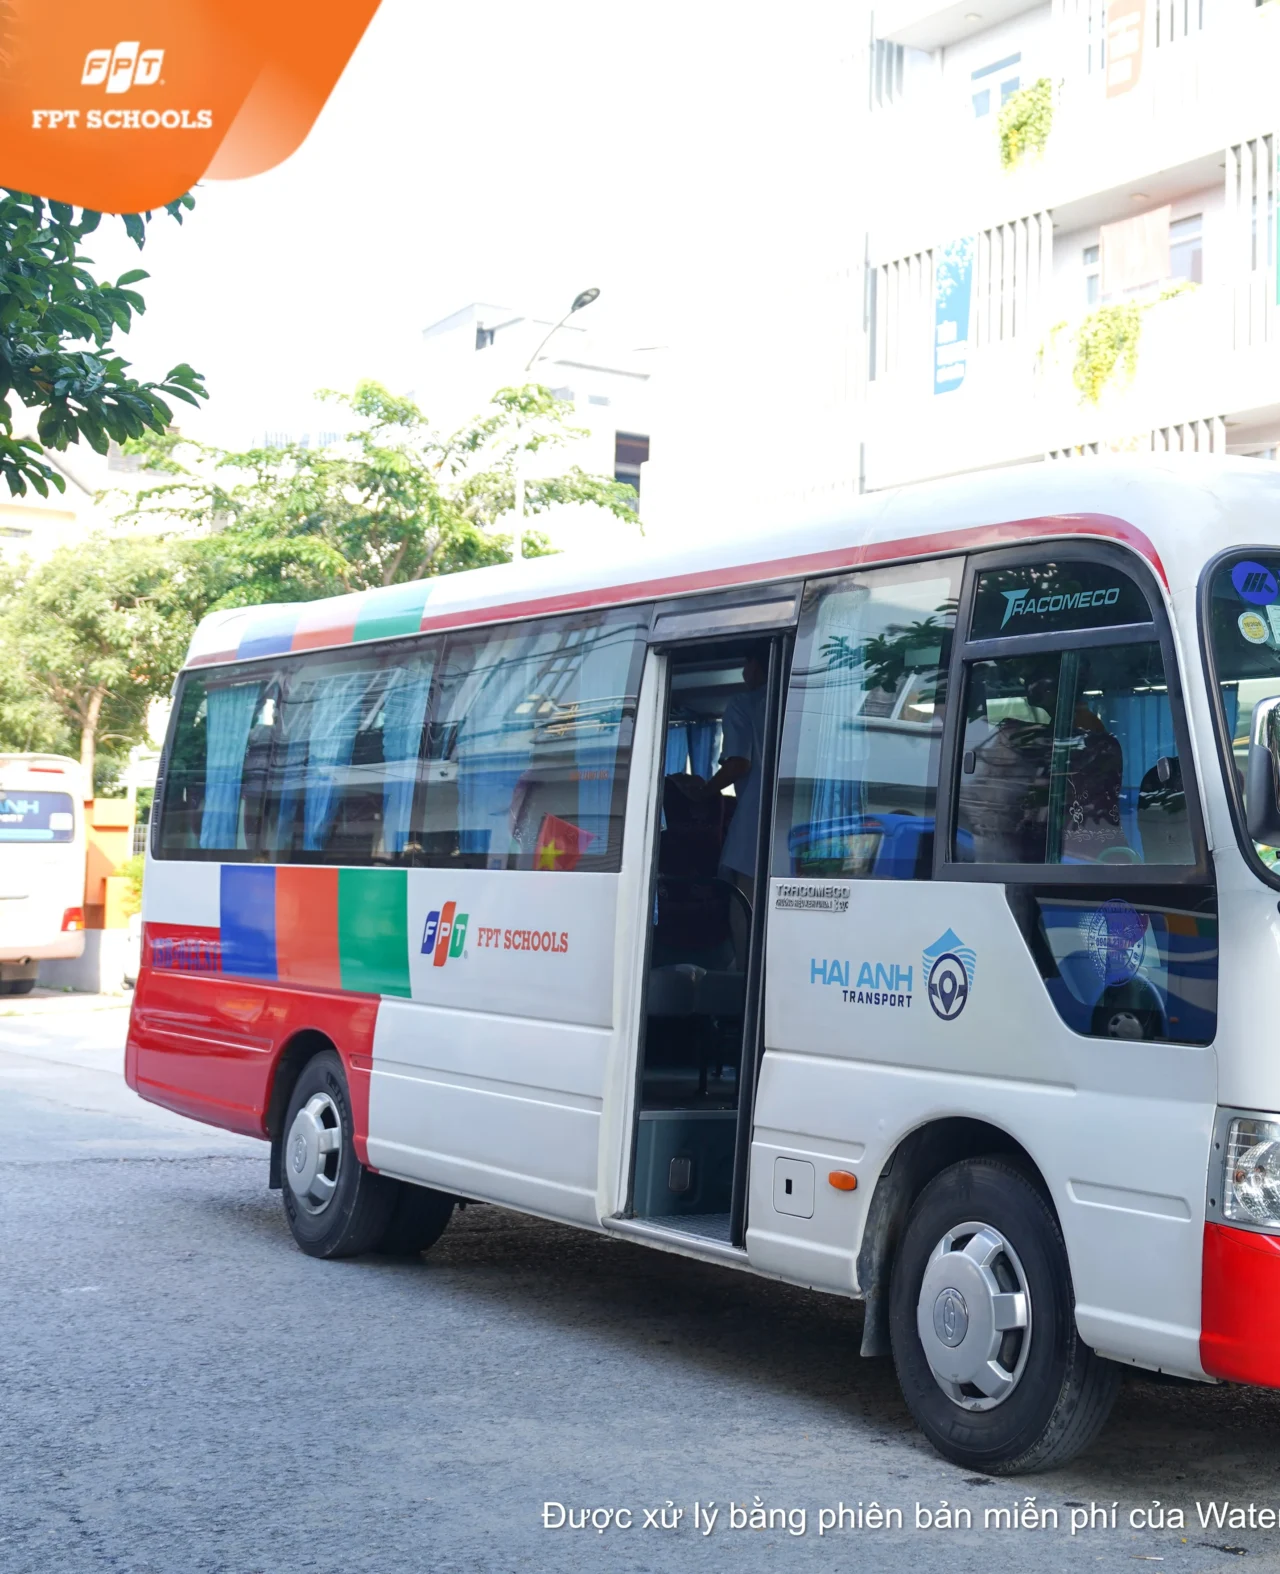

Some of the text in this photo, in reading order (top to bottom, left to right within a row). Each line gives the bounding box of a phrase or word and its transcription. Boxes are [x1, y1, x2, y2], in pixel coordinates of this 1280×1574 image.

[1000, 587, 1120, 631] TRACOMECO
[776, 884, 851, 899] TRACOMECO
[477, 927, 569, 953] FPT SCHOOLS
[811, 958, 913, 992] HAI ANH
[843, 990, 912, 1008] TRANSPORT
